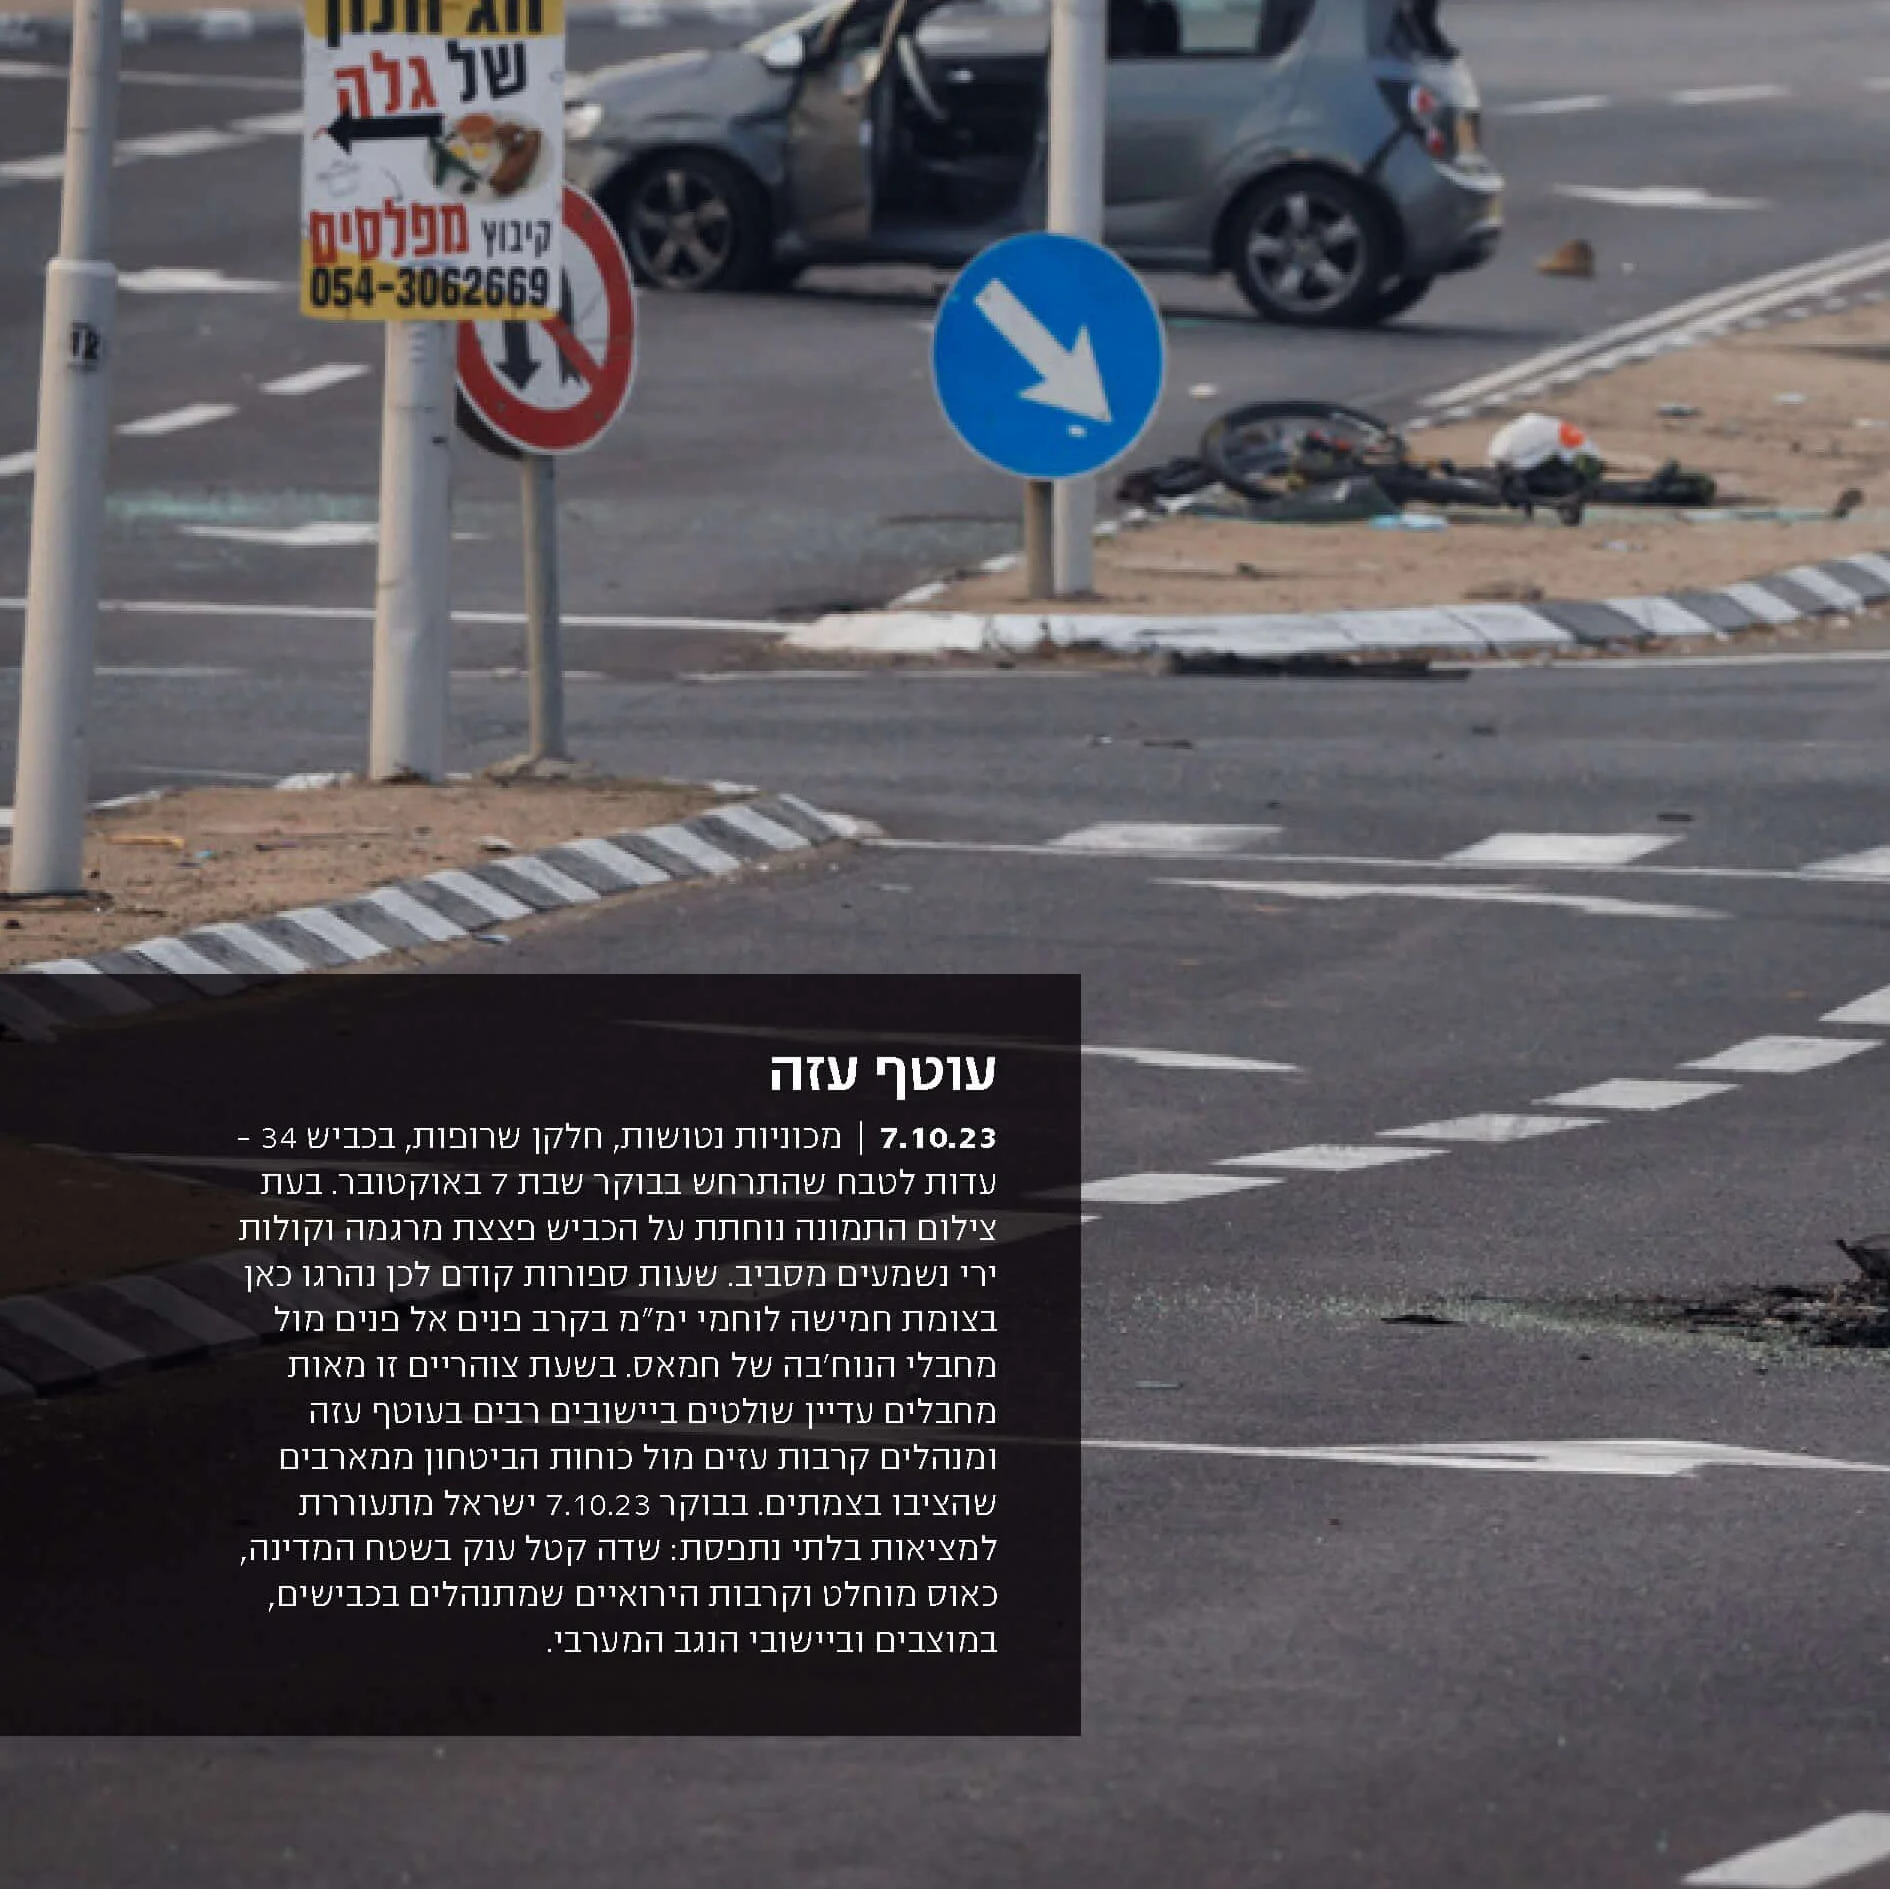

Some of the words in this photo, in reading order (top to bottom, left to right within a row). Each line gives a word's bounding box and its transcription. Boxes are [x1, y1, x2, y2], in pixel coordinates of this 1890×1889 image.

[334, 49, 439, 121] גלה
[447, 39, 527, 103] של
[310, 197, 470, 265] מפלסים
[480, 220, 552, 258] קיבוץ
[310, 265, 549, 308] 054-3062669
